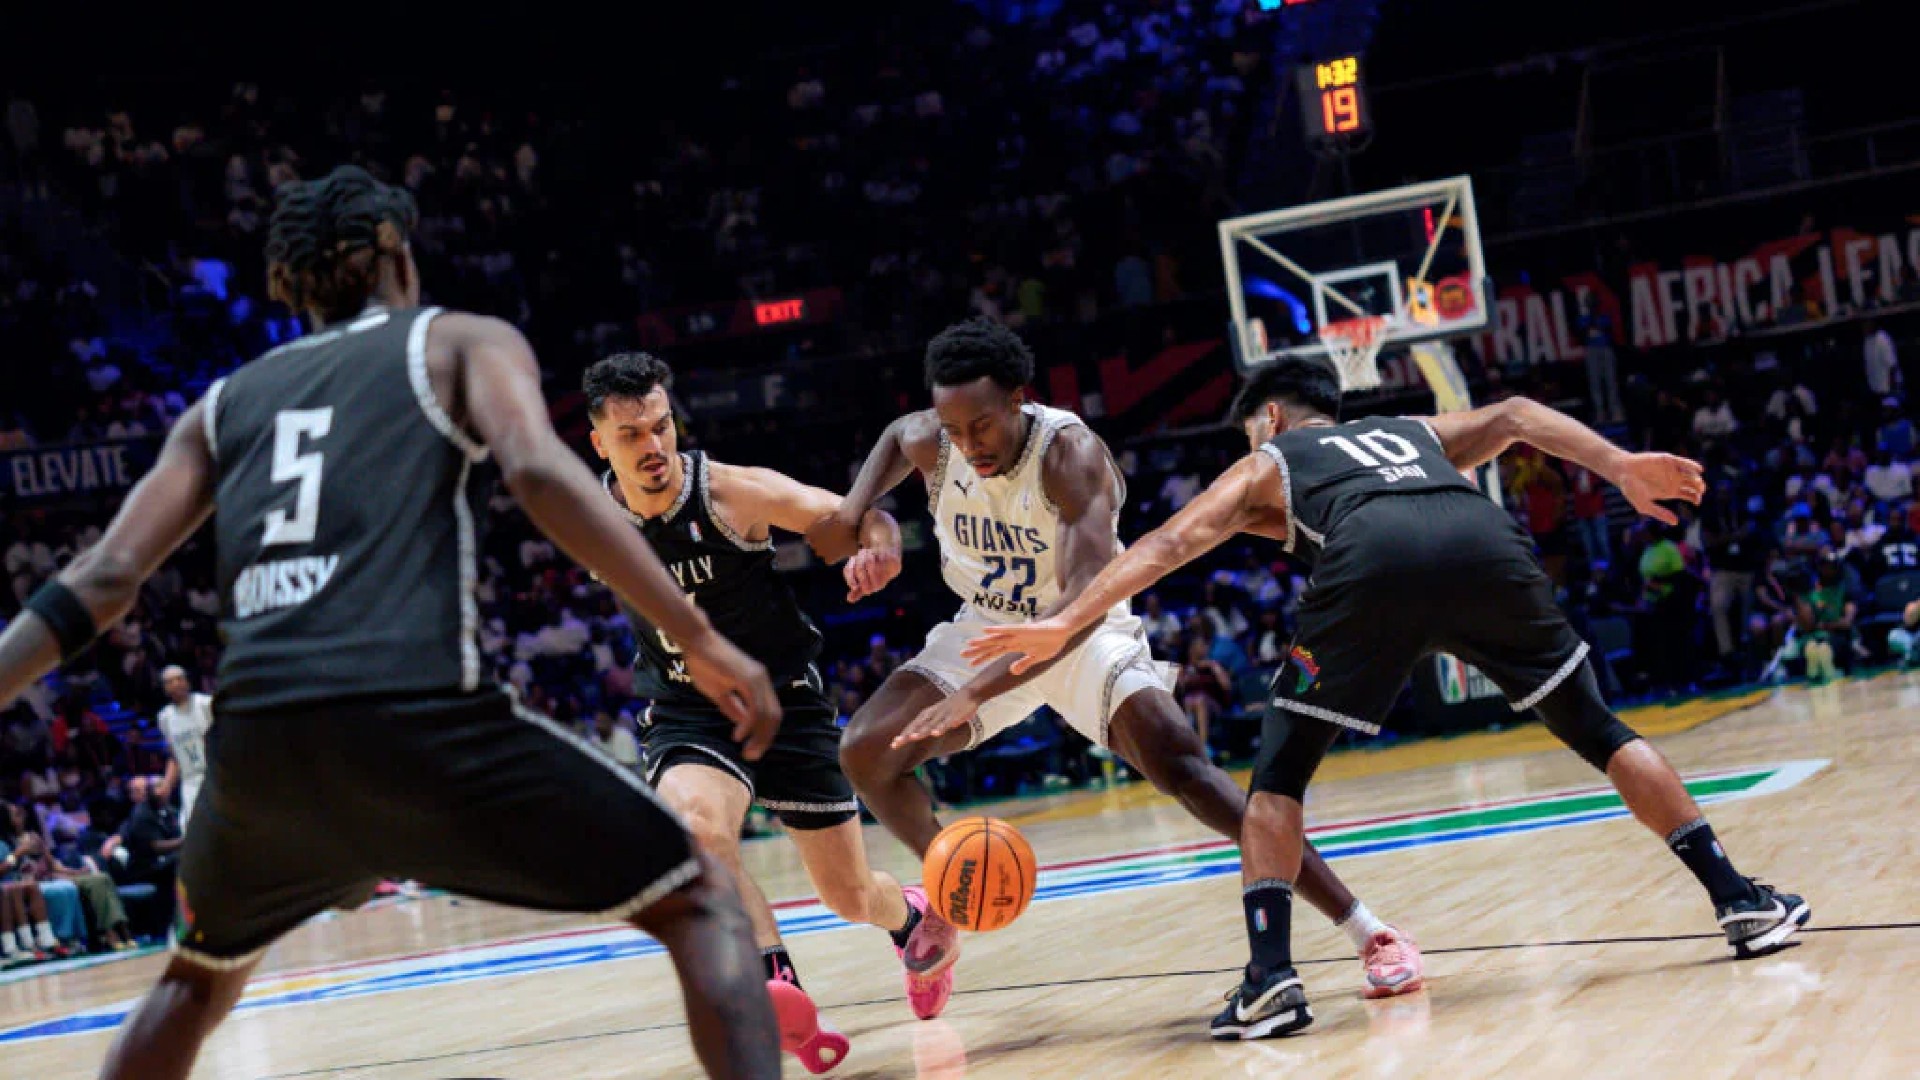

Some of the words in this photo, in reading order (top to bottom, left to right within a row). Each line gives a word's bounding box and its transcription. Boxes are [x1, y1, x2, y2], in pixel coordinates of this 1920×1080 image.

[1323, 87, 1359, 134] 19
[755, 298, 804, 325] EXIT
[1629, 252, 1793, 347] AFRICA
[10, 445, 132, 496] ELEVATE
[1317, 427, 1421, 467] 10
[261, 406, 333, 546] 5
[953, 512, 1049, 554] GIANTS
[232, 553, 340, 620] BOISSY
[980, 554, 1038, 618] 22
[949, 859, 977, 926] Wilson
